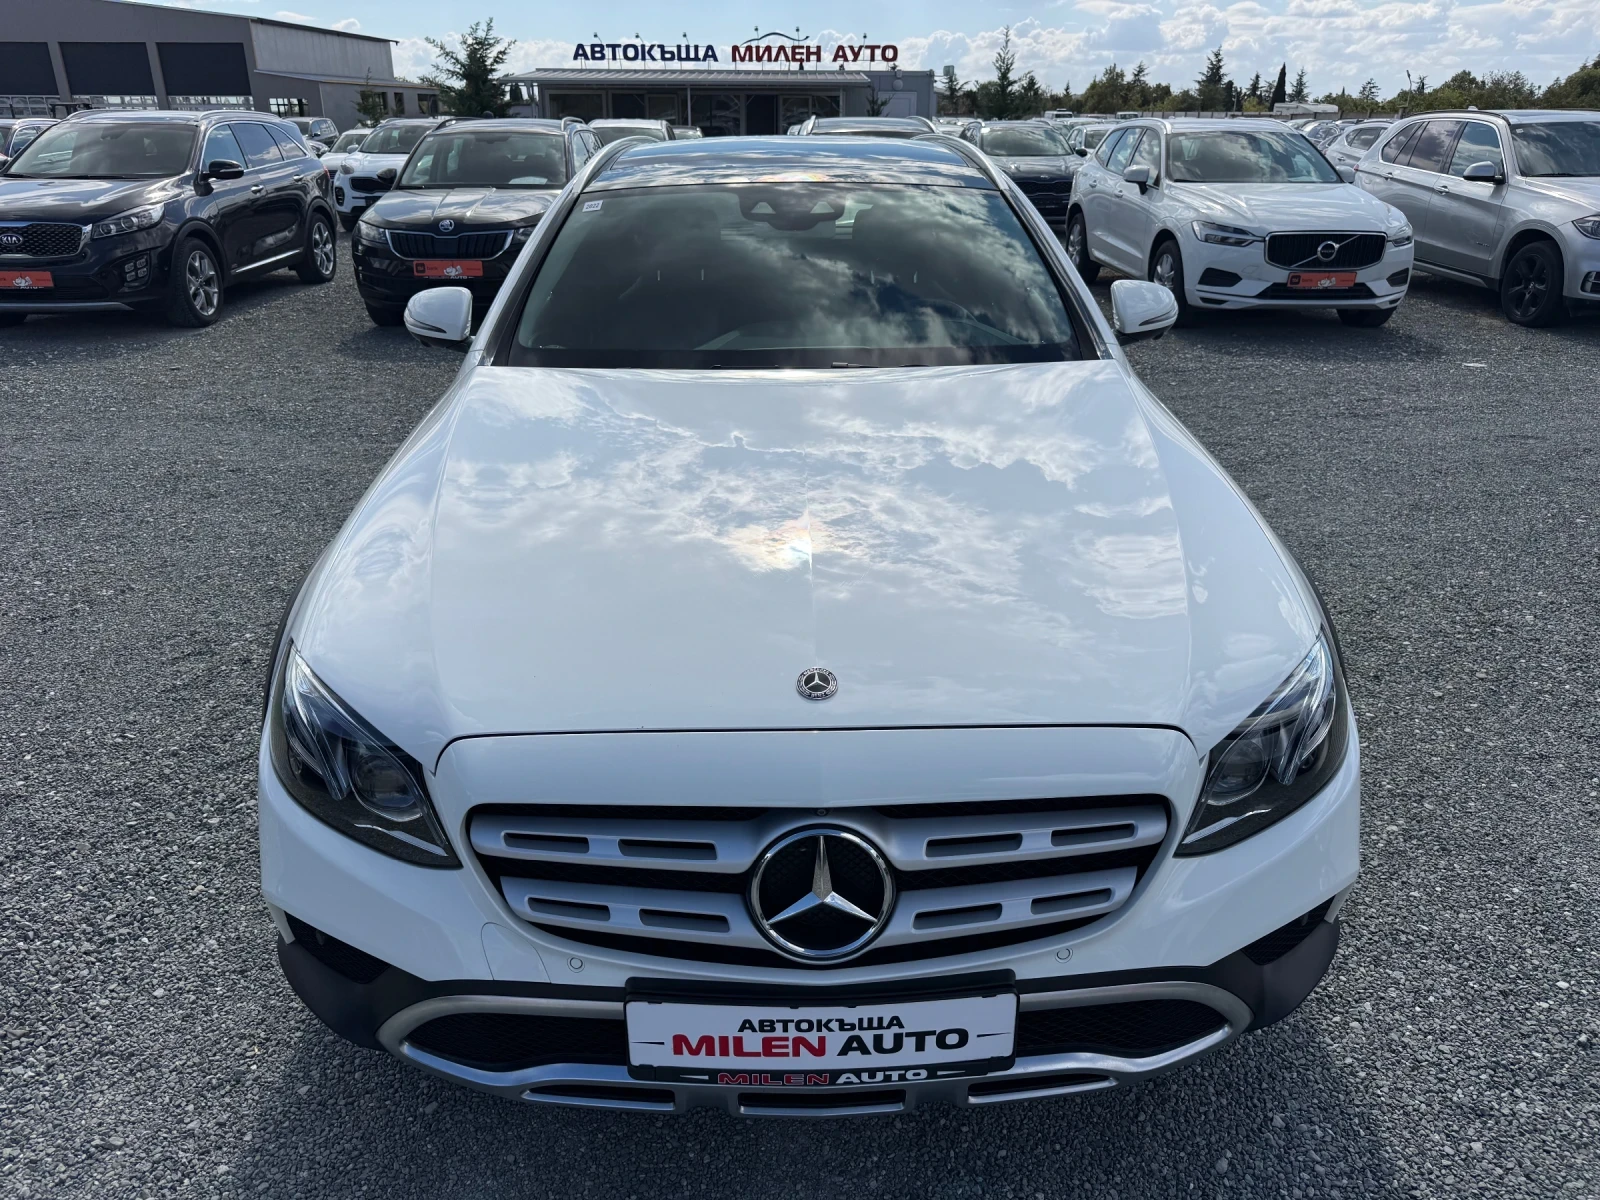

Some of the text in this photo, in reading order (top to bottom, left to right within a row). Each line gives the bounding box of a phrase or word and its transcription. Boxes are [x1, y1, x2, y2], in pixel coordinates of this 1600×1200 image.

[573, 43, 899, 63] АВТОКЪЩА МИЛЕН АУТО
[1, 236, 19, 244] KIA
[737, 1015, 905, 1033] АВТОКЪЩА
[672, 1027, 969, 1058] MILEN AUTO
[717, 1068, 928, 1085] MILEN AUTO
